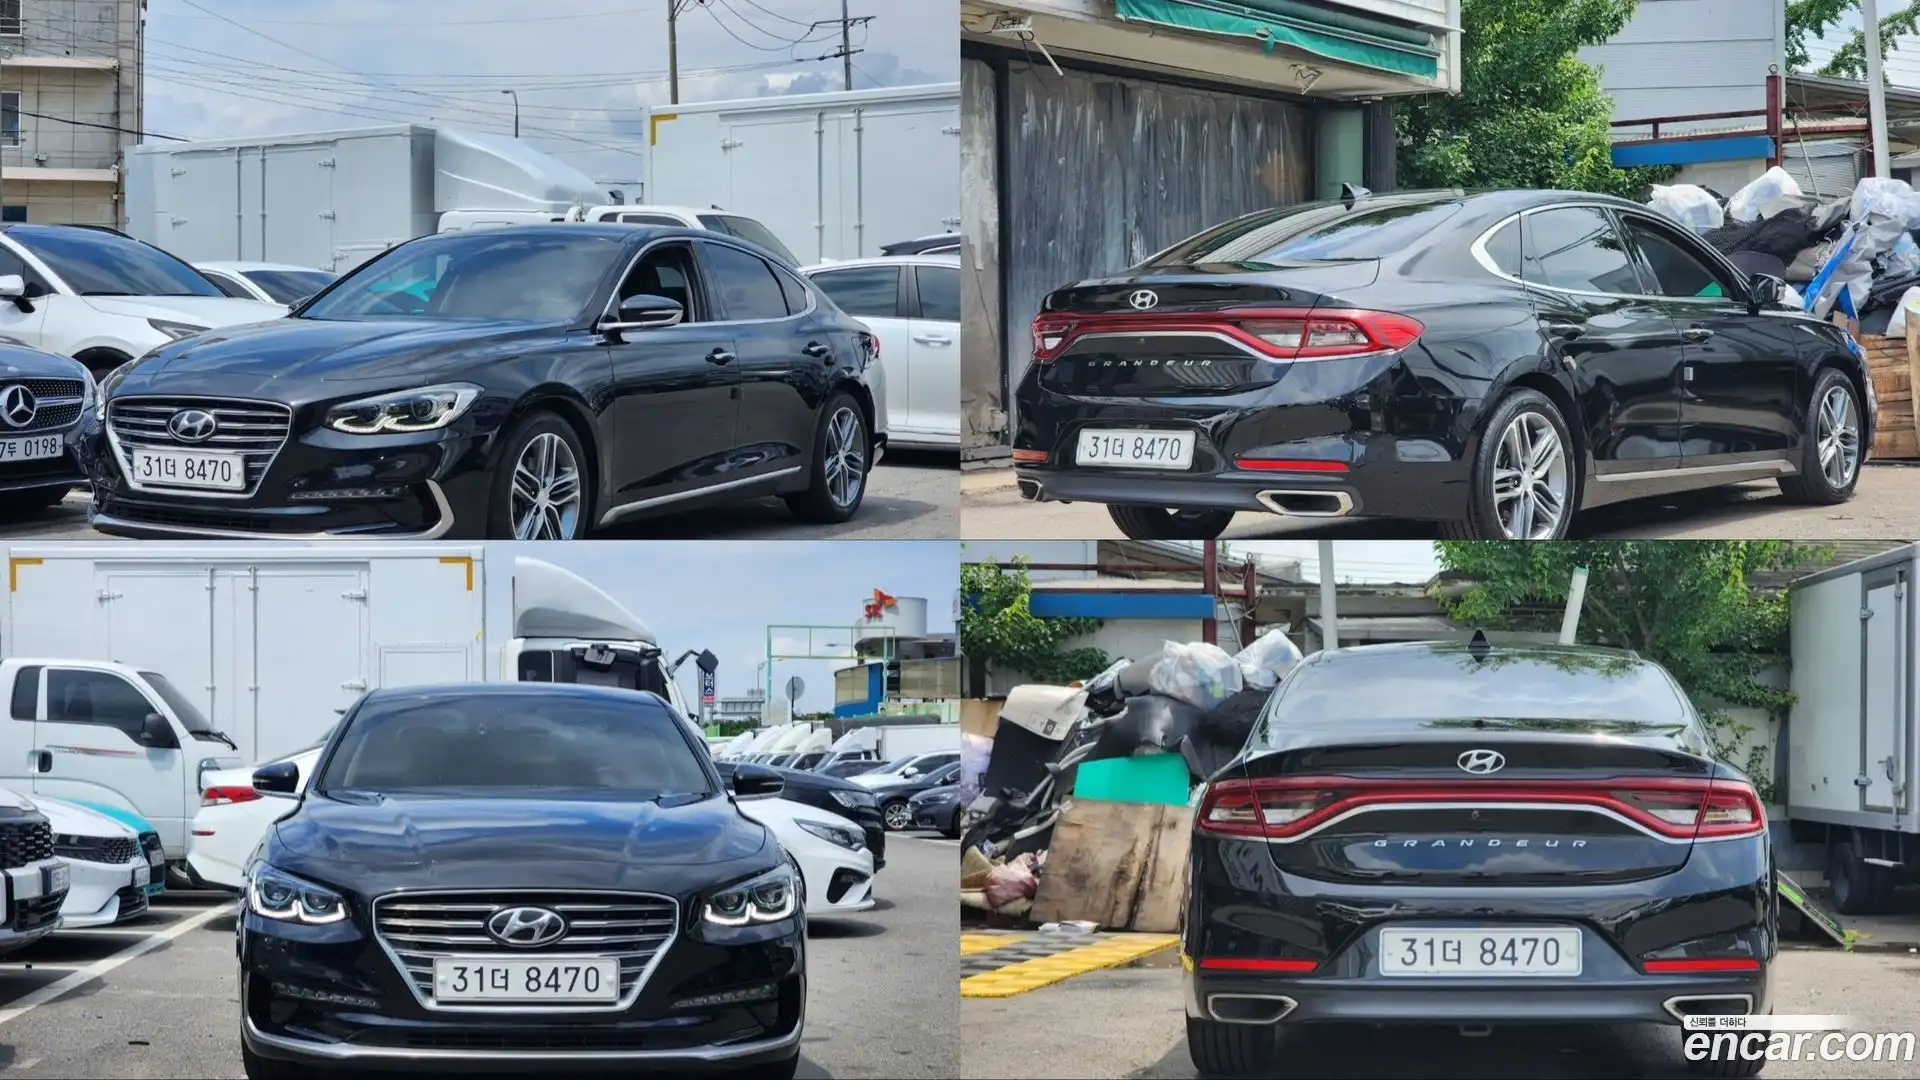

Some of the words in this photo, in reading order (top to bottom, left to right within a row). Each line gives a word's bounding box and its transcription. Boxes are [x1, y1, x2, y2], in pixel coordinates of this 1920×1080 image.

[1088, 359, 1212, 368] GRANDEUR
[24, 437, 57, 457] 0198
[1088, 436, 1125, 459] 31더
[1132, 436, 1182, 461] 8470
[142, 455, 176, 478] 31더
[184, 457, 232, 482] 8470
[1373, 839, 1587, 848] GRANDEUR
[1400, 937, 1462, 966] 31더
[1479, 937, 1560, 966] 8470
[452, 966, 509, 992] 31더
[525, 966, 600, 992] 8470
